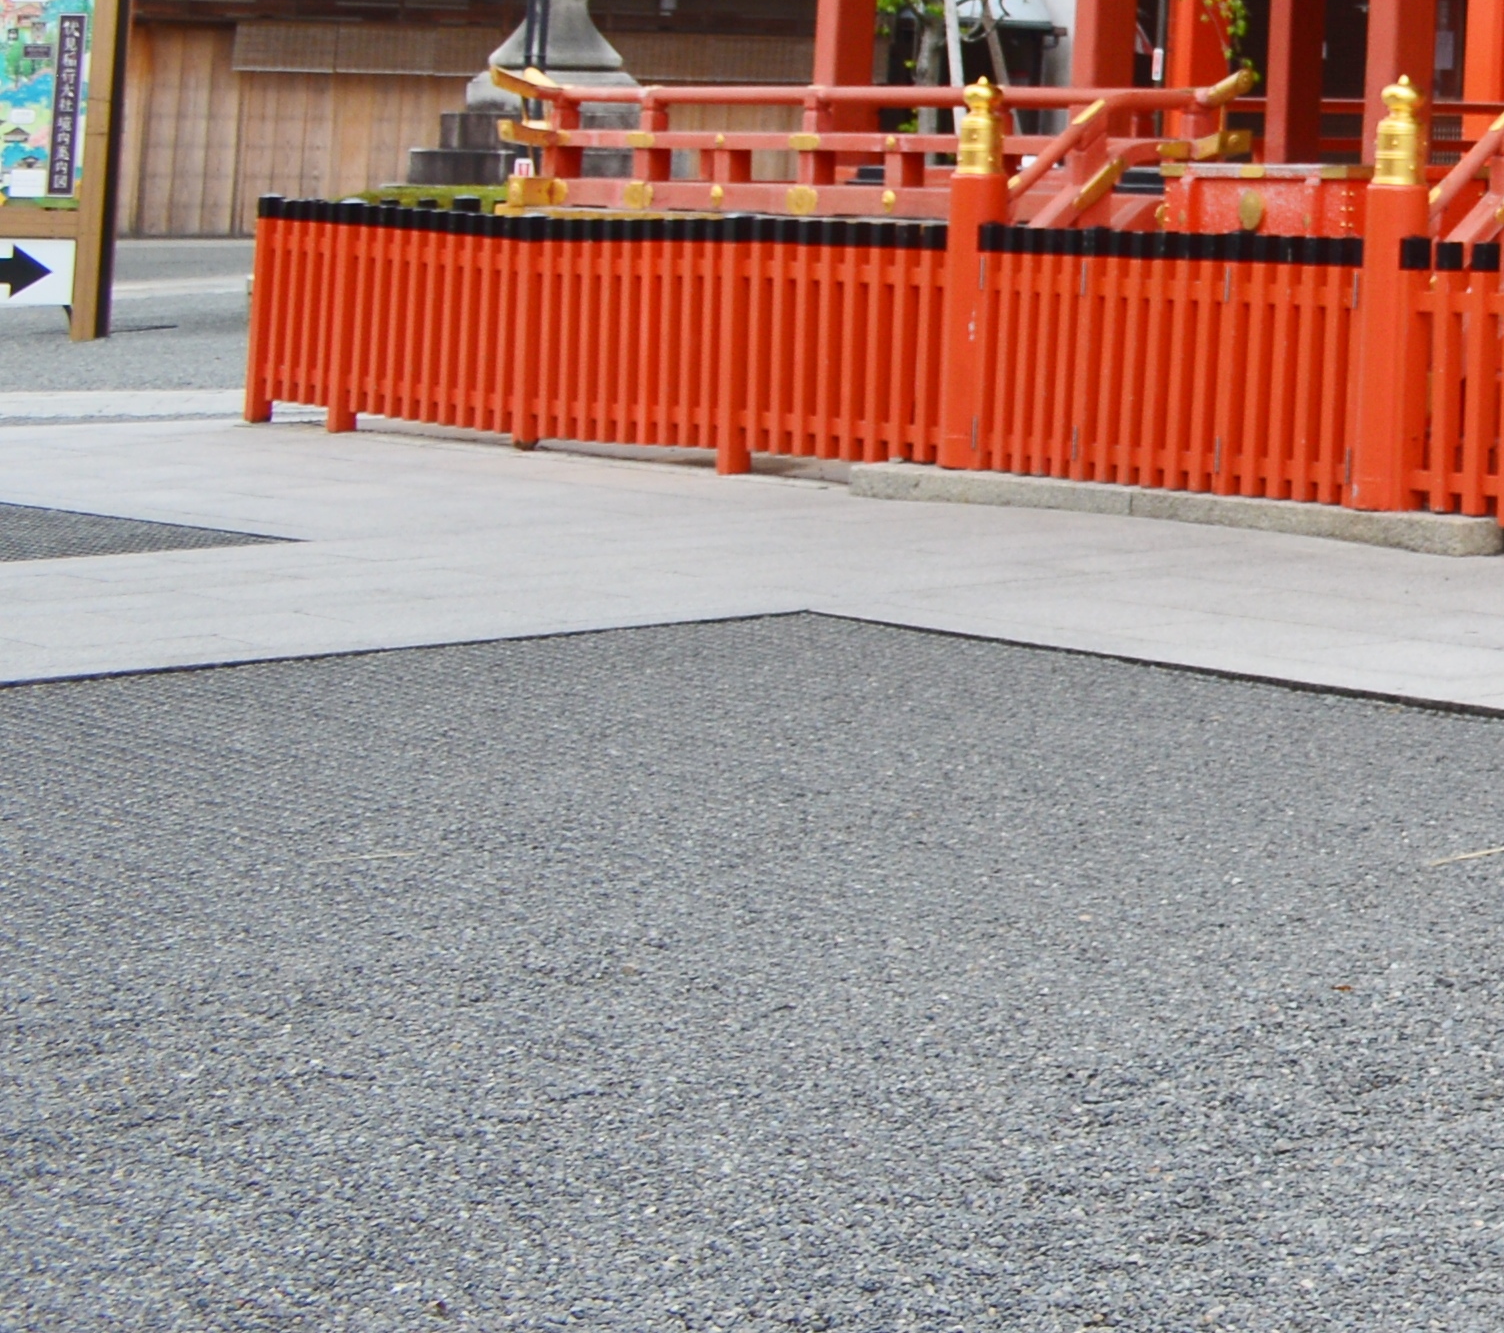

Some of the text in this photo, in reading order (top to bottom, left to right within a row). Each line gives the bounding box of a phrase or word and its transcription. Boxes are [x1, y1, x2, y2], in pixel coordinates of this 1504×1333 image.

[58, 19, 80, 112] 伏見稲荷大社
